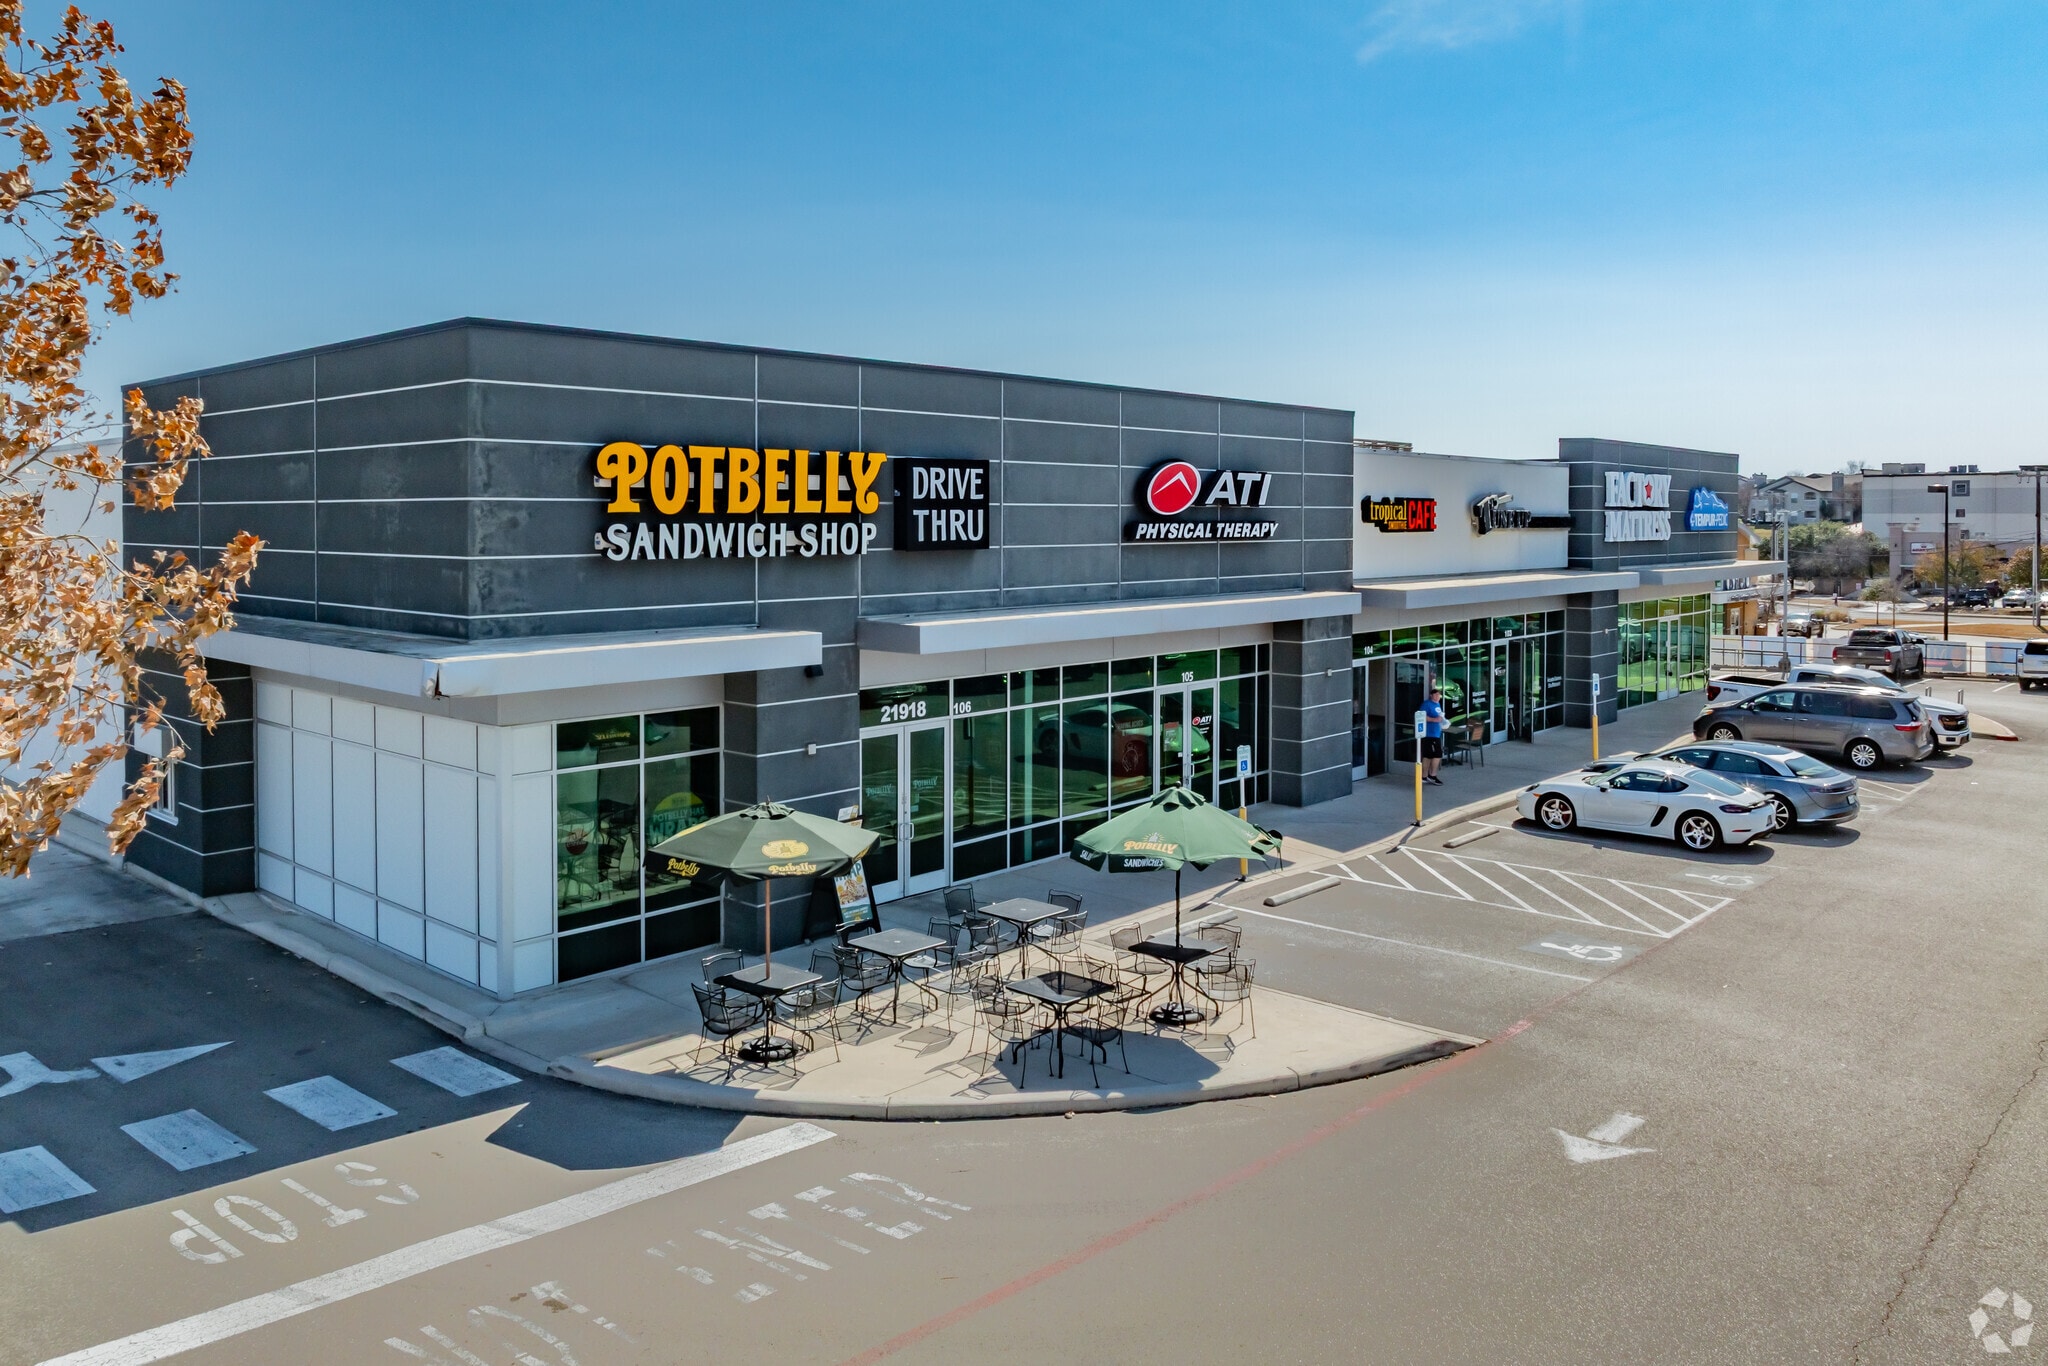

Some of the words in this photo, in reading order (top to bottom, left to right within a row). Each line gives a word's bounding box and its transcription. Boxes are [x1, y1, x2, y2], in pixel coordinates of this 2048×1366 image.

[597, 441, 887, 515] POTBELLY
[913, 467, 984, 501] DRIVE
[1205, 472, 1272, 506] ATI
[1604, 471, 1672, 508] FACTORY
[1370, 500, 1407, 525] tropical
[1408, 500, 1438, 530] CAFE
[913, 509, 984, 542] THRU
[1136, 522, 1212, 540] PHYSICAL
[1216, 522, 1279, 538] THERAPY
[1604, 510, 1672, 542] MATTRESS
[606, 522, 787, 562] SANDWICH
[800, 522, 878, 558] SHOP
[1181, 671, 1194, 683] 105
[880, 700, 927, 723] 21918
[953, 700, 972, 715] 106
[1199, 715, 1212, 723] ATI
[1123, 840, 1179, 854] POTBELLY
[667, 858, 701, 875] Potbelly
[768, 862, 817, 875] Potbelly
[1123, 858, 1164, 868] SANDWICHES
[168, 1160, 421, 1266] STOP
